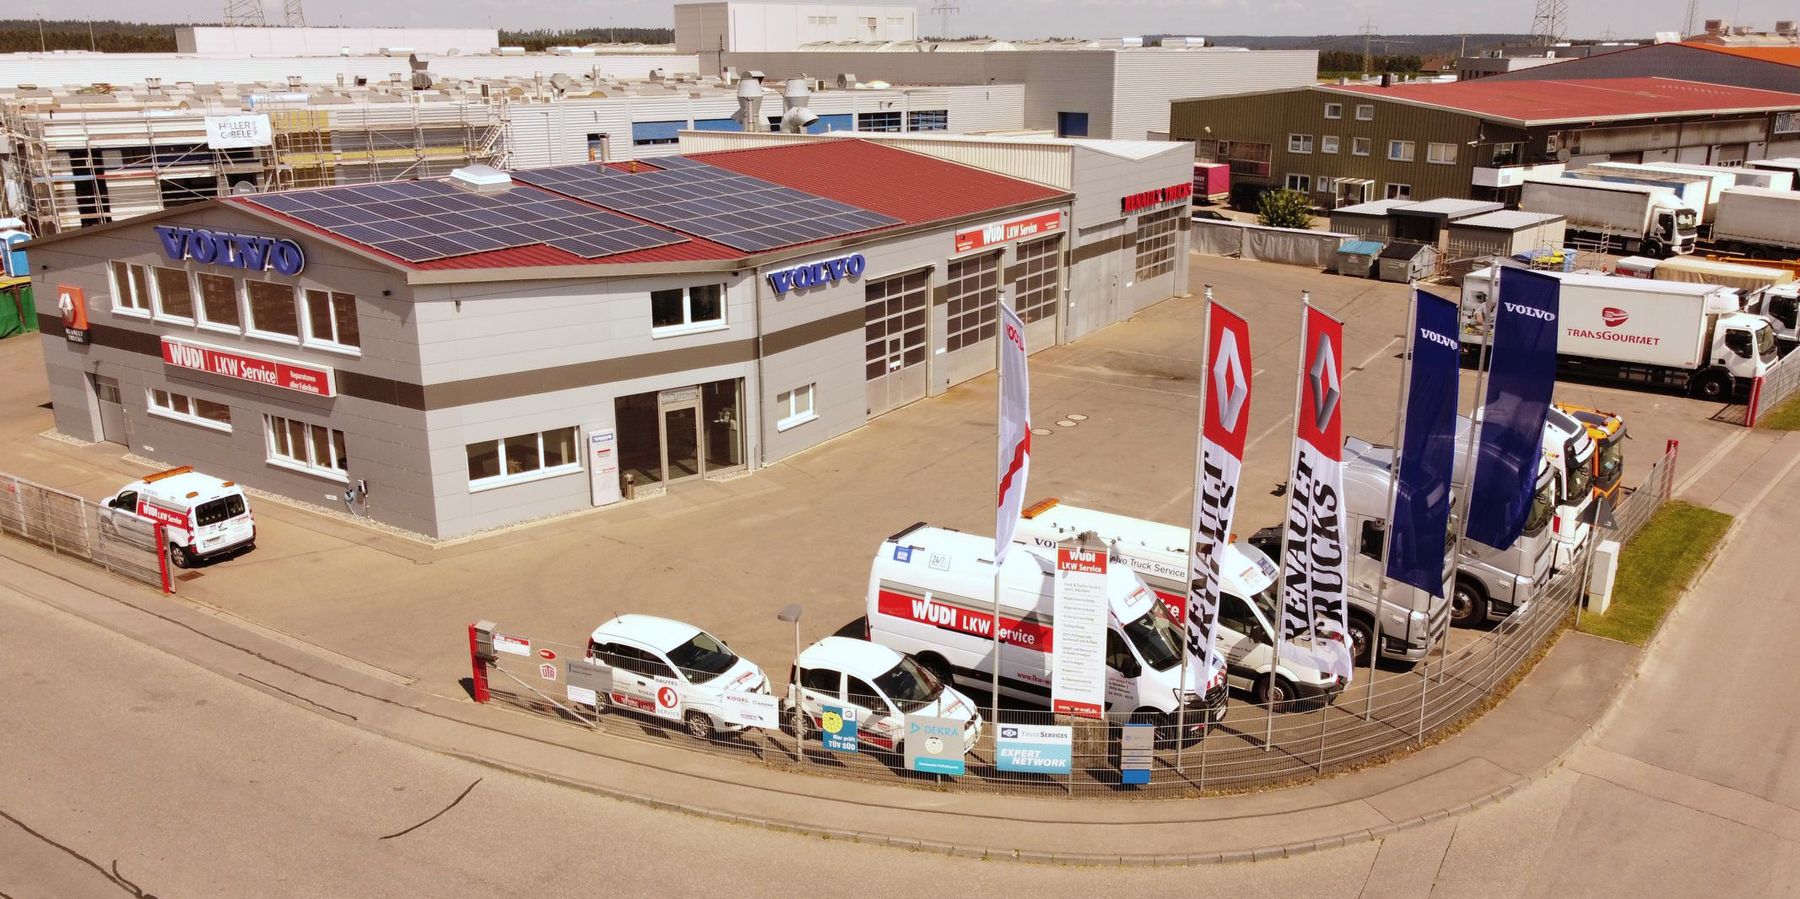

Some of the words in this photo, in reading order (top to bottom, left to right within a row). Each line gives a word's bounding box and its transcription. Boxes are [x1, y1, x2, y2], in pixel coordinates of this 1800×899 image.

[982, 223, 1004, 245] WUDI
[1007, 224, 1019, 240] LKW
[1020, 223, 1038, 236] Service
[153, 225, 305, 276] VOLVO
[765, 252, 866, 294] VOLVO
[1503, 302, 1556, 322] VOLVO
[1420, 328, 1458, 350] VOLVO
[169, 342, 205, 370] WUDI
[214, 355, 238, 376] LKW
[241, 361, 277, 384] Service
[1069, 545, 1096, 562] WUDI
[1284, 451, 1313, 642] RENAULT
[1062, 561, 1078, 570] LKW
[1079, 563, 1102, 573] Service
[1130, 558, 1152, 570] Truck
[1154, 563, 1185, 577] Service
[1311, 479, 1344, 644] TRUCKS
[912, 591, 957, 627] WUDI
[962, 615, 991, 635] LKW
[924, 725, 959, 737] DEKRA
[828, 740, 841, 748] TÜV
[842, 742, 856, 751] SÜD
[1001, 748, 1041, 758] EXPERT
[1012, 757, 1066, 767] NETWORK
